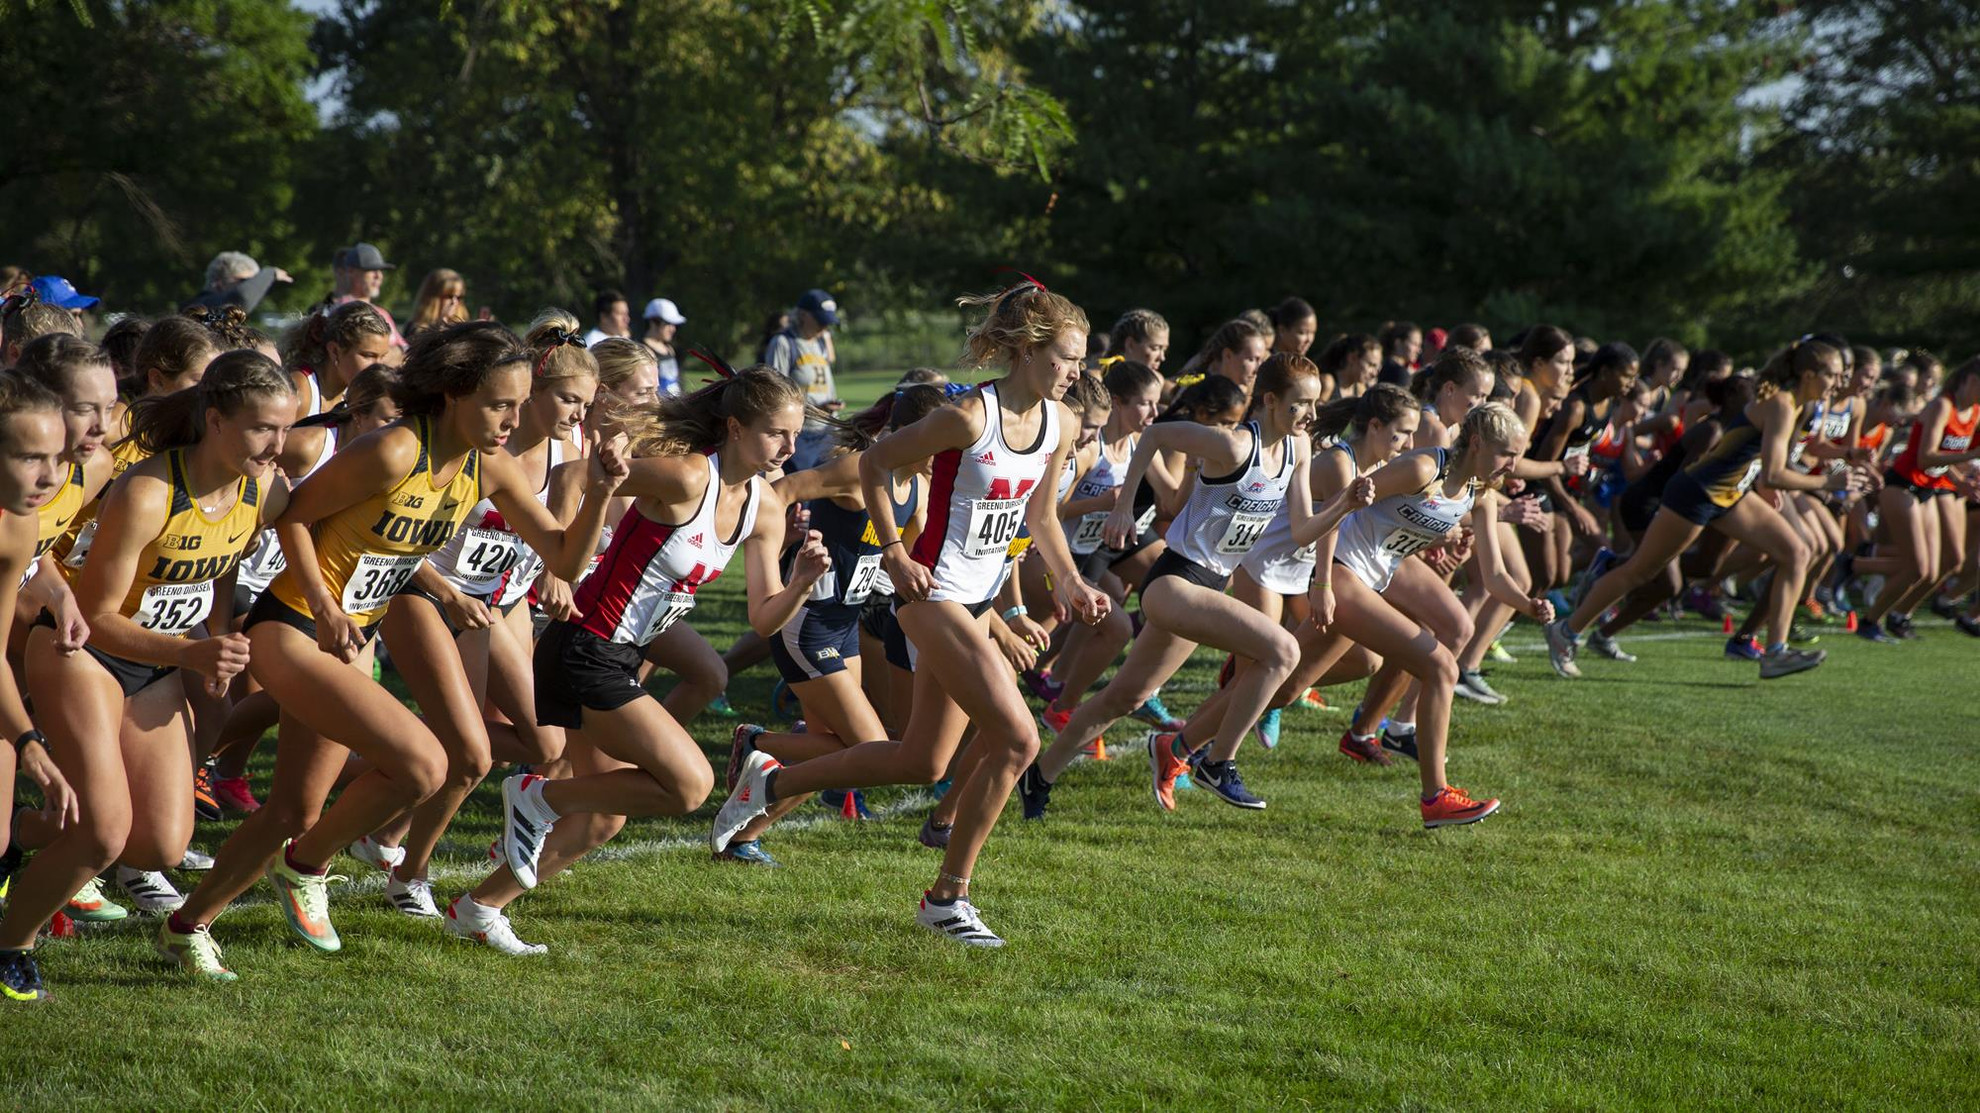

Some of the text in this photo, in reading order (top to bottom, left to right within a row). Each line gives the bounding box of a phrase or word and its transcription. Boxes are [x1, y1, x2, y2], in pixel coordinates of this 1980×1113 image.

[371, 509, 456, 547] IOWA
[978, 510, 1019, 546] 405
[1228, 523, 1265, 548] 314
[467, 542, 519, 574] 420
[353, 568, 411, 600] 368
[140, 597, 203, 630] 352
